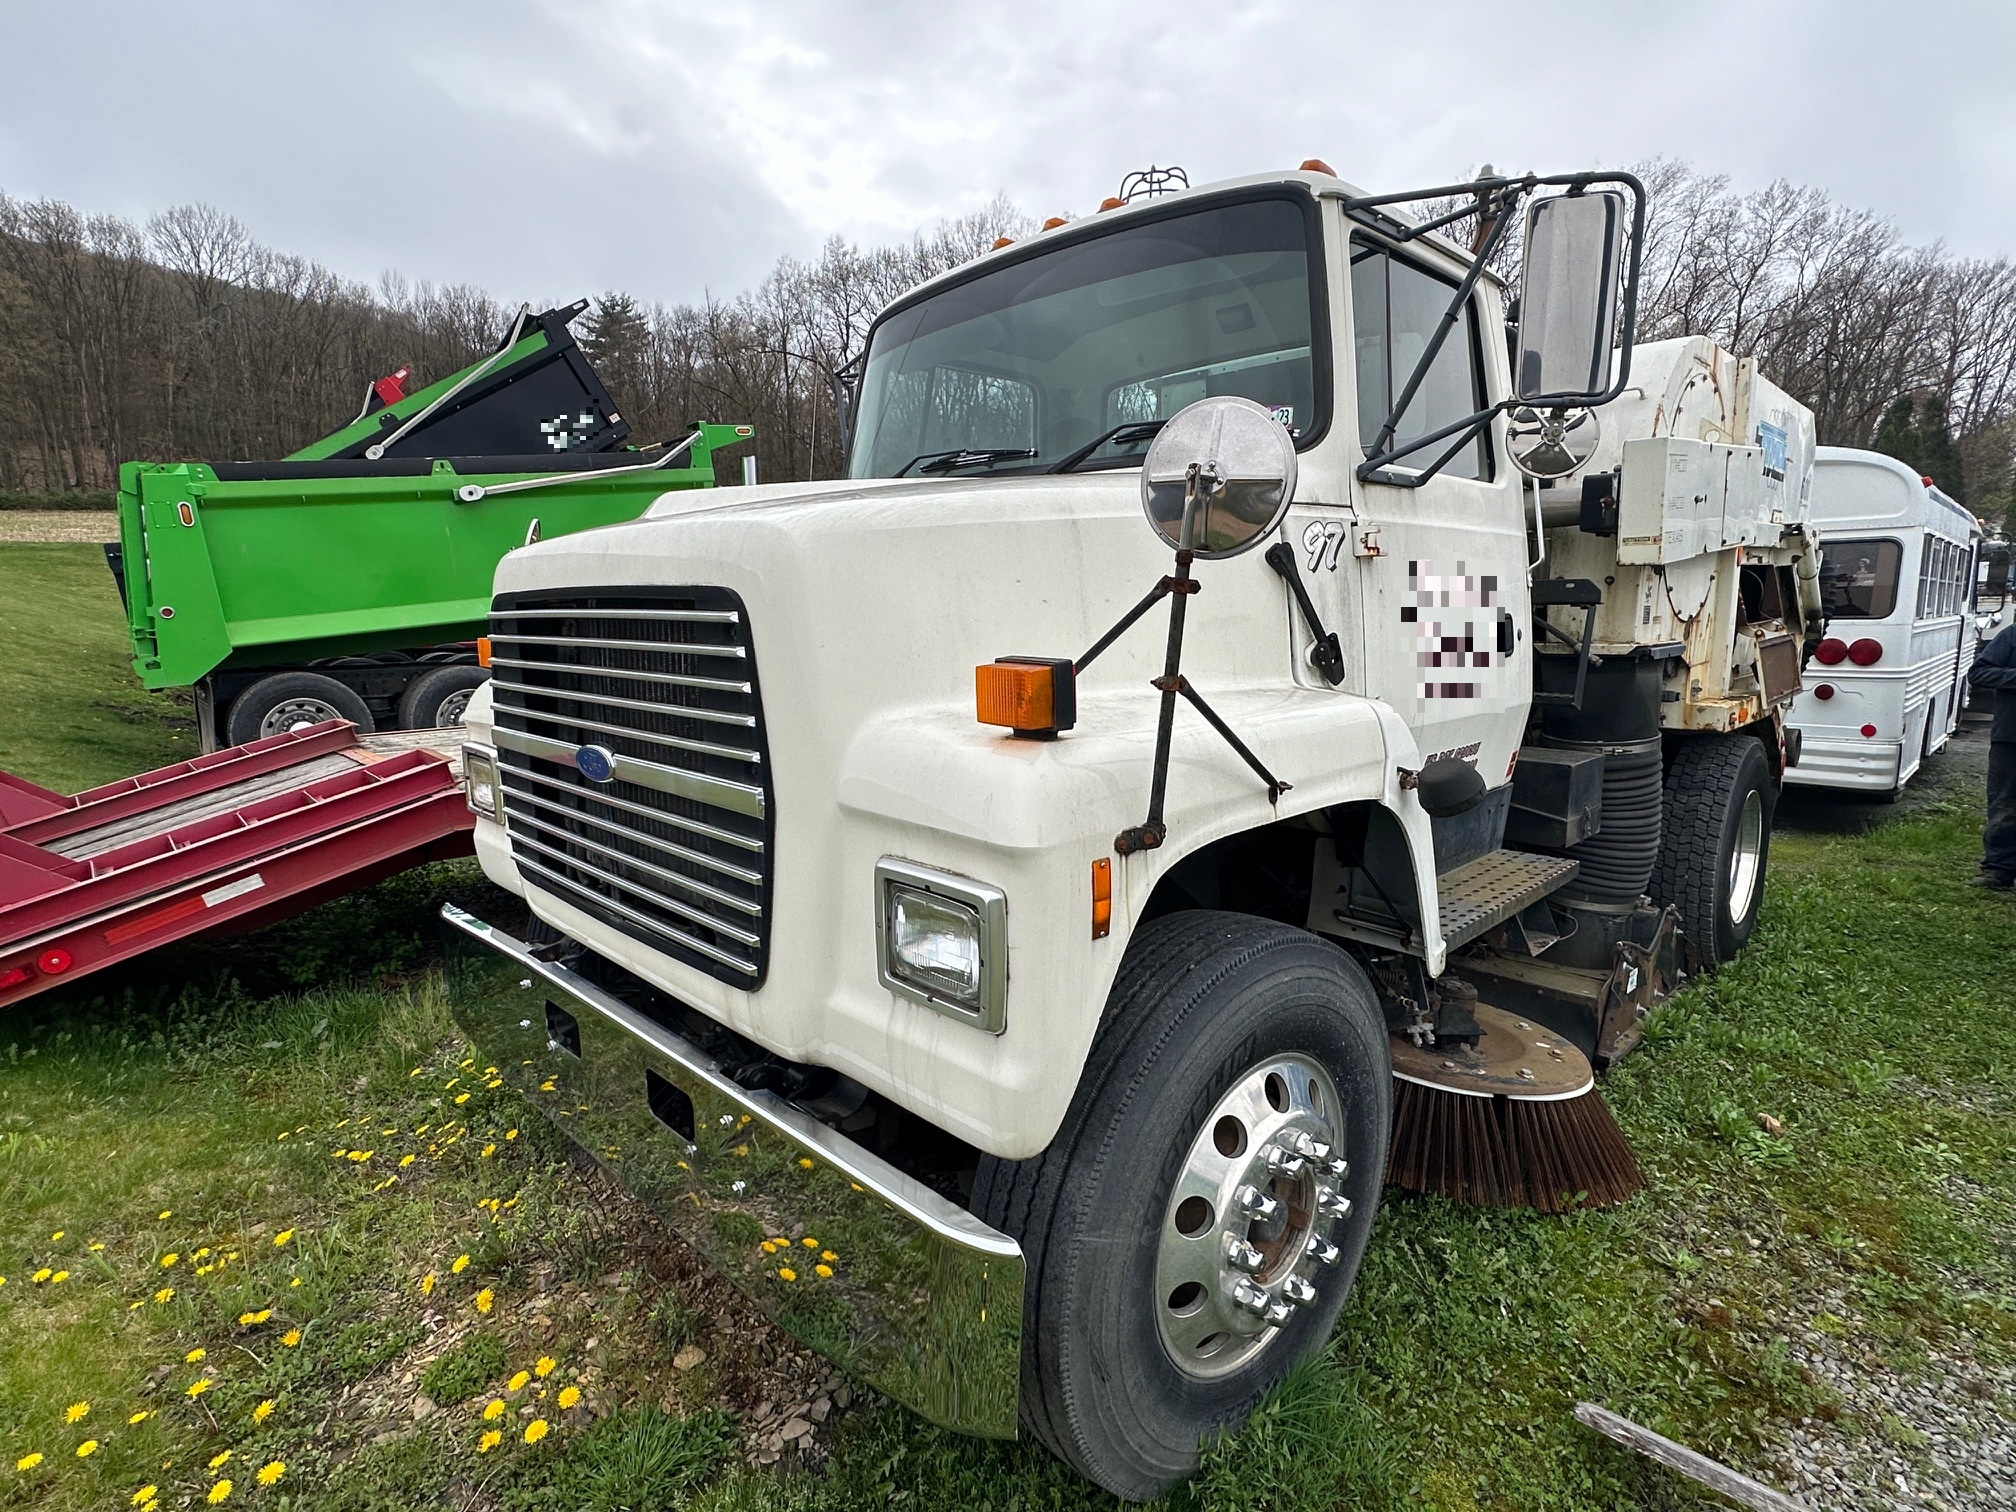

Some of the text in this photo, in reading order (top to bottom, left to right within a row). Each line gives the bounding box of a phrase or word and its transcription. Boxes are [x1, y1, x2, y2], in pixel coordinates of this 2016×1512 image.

[1279, 408, 1290, 426] 23
[1302, 520, 1346, 574] 97
[1139, 1032, 1256, 1247] MICHELIN
